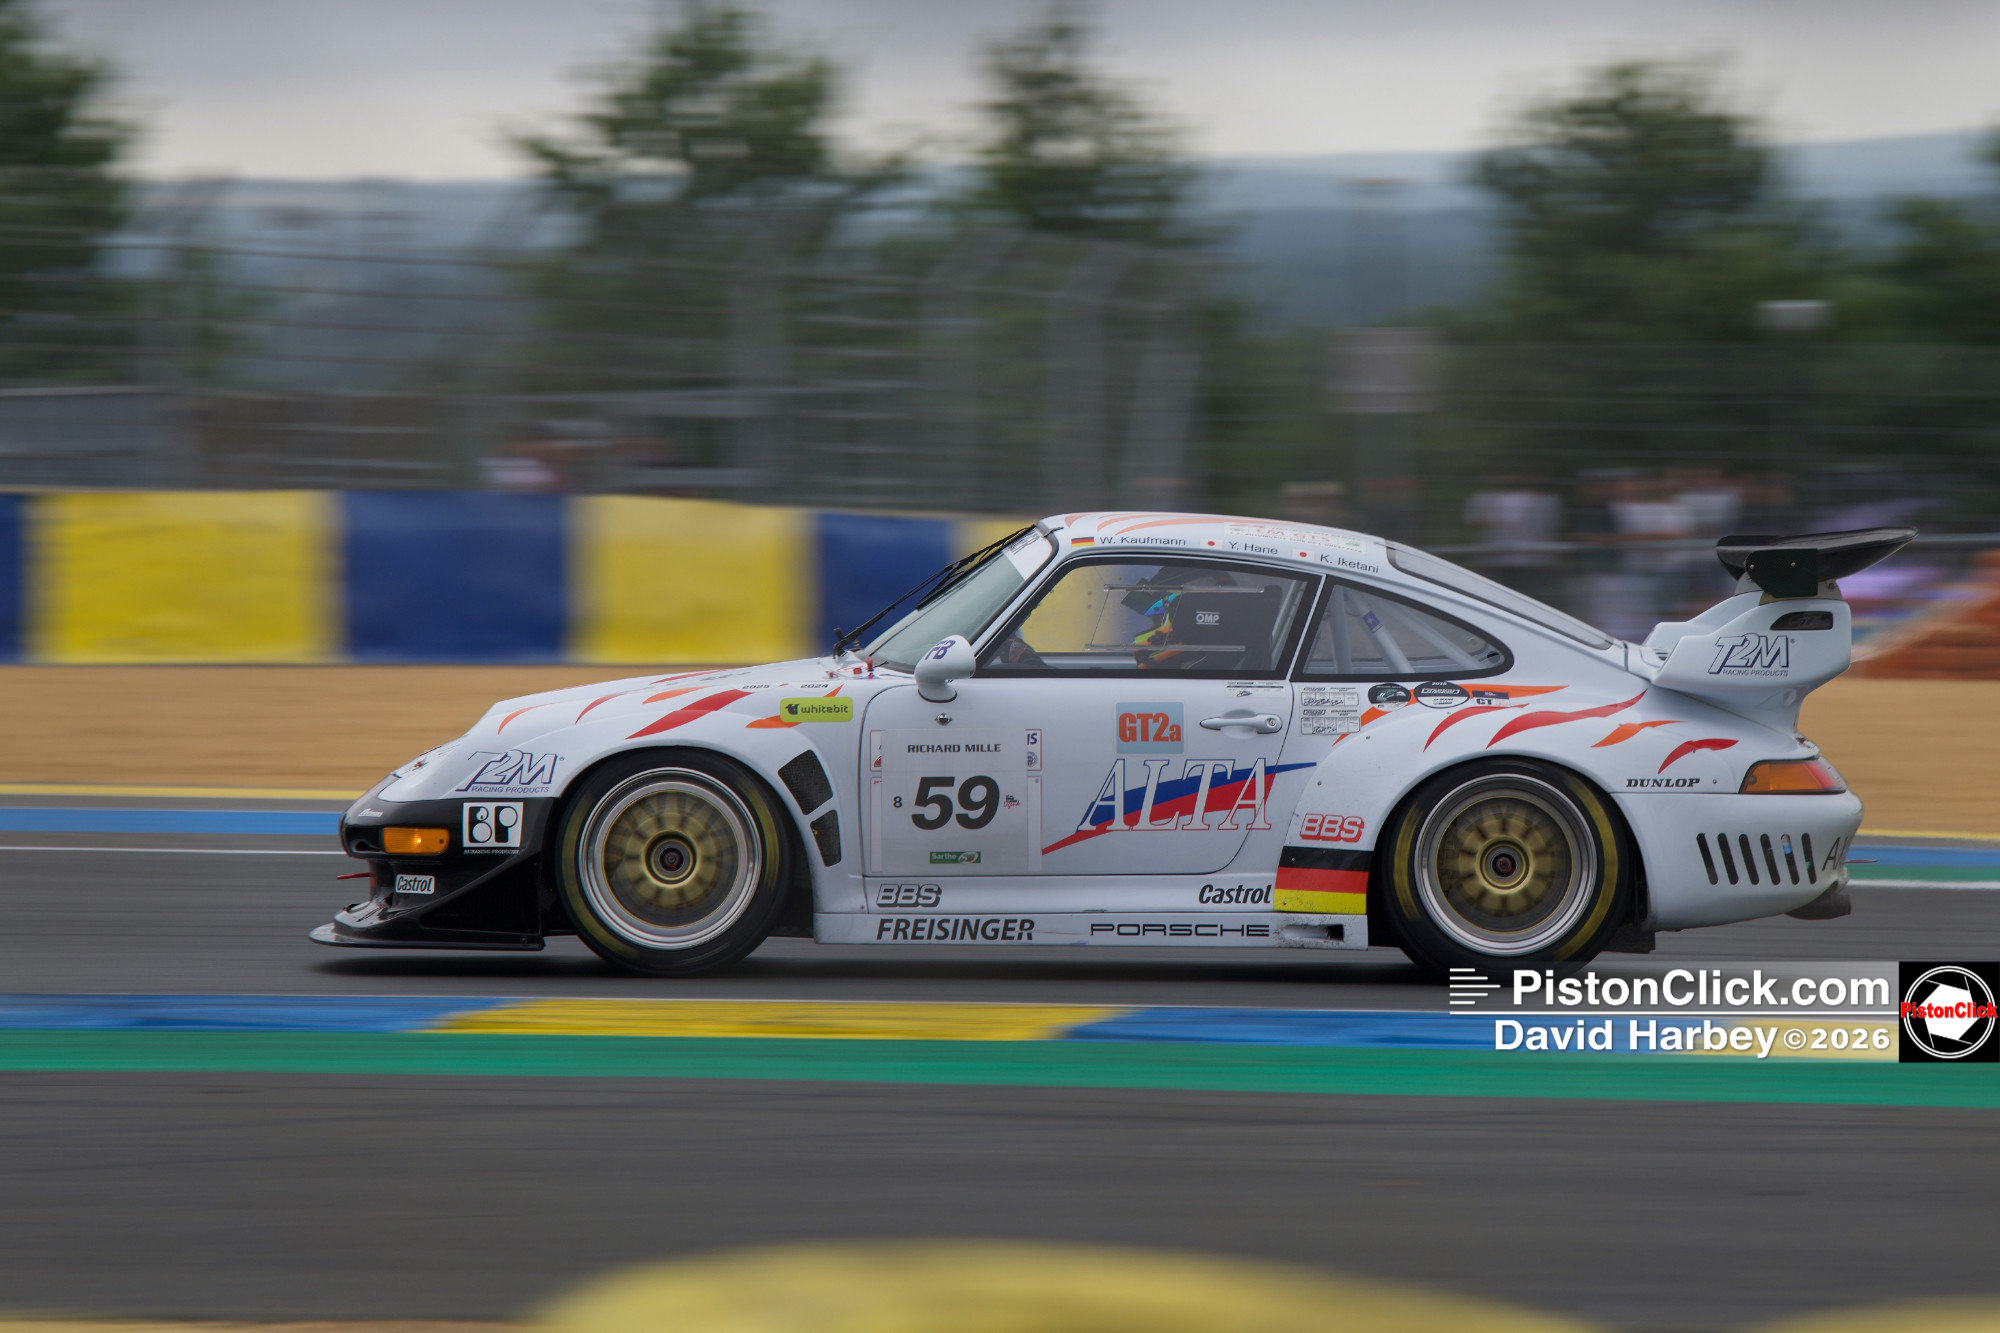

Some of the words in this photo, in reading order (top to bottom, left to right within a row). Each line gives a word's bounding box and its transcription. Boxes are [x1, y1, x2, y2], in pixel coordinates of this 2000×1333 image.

[1100, 537, 1116, 545] W.
[1121, 536, 1186, 546] Kaufmann
[1229, 541, 1239, 550] Y.
[1244, 543, 1278, 555] Hane
[1320, 553, 1333, 564] K.
[1337, 557, 1379, 573] Iketani
[1196, 613, 1220, 624] OMP
[1708, 632, 1790, 675] T2M
[1750, 669, 1788, 677] PRODUCTS
[801, 704, 849, 714] whitebit
[1118, 712, 1182, 743] GT2a
[907, 744, 961, 753] RICHARD
[964, 743, 1001, 753] MILLE
[455, 749, 559, 792] T2M
[471, 786, 504, 794] RACING
[505, 786, 550, 794] PRODUCTS
[1626, 778, 1700, 788] DUNLOP
[893, 796, 903, 808] 8
[1076, 757, 1272, 831] ALTA
[911, 775, 1000, 831] 59
[1299, 813, 1365, 843] BBS
[931, 852, 957, 860] Sarthe
[396, 875, 433, 892] Castrol
[876, 884, 942, 908] BBS
[1199, 884, 1271, 905] Castrol
[876, 918, 1035, 941] FREISINGER
[1090, 922, 1270, 938] PORSCHE
